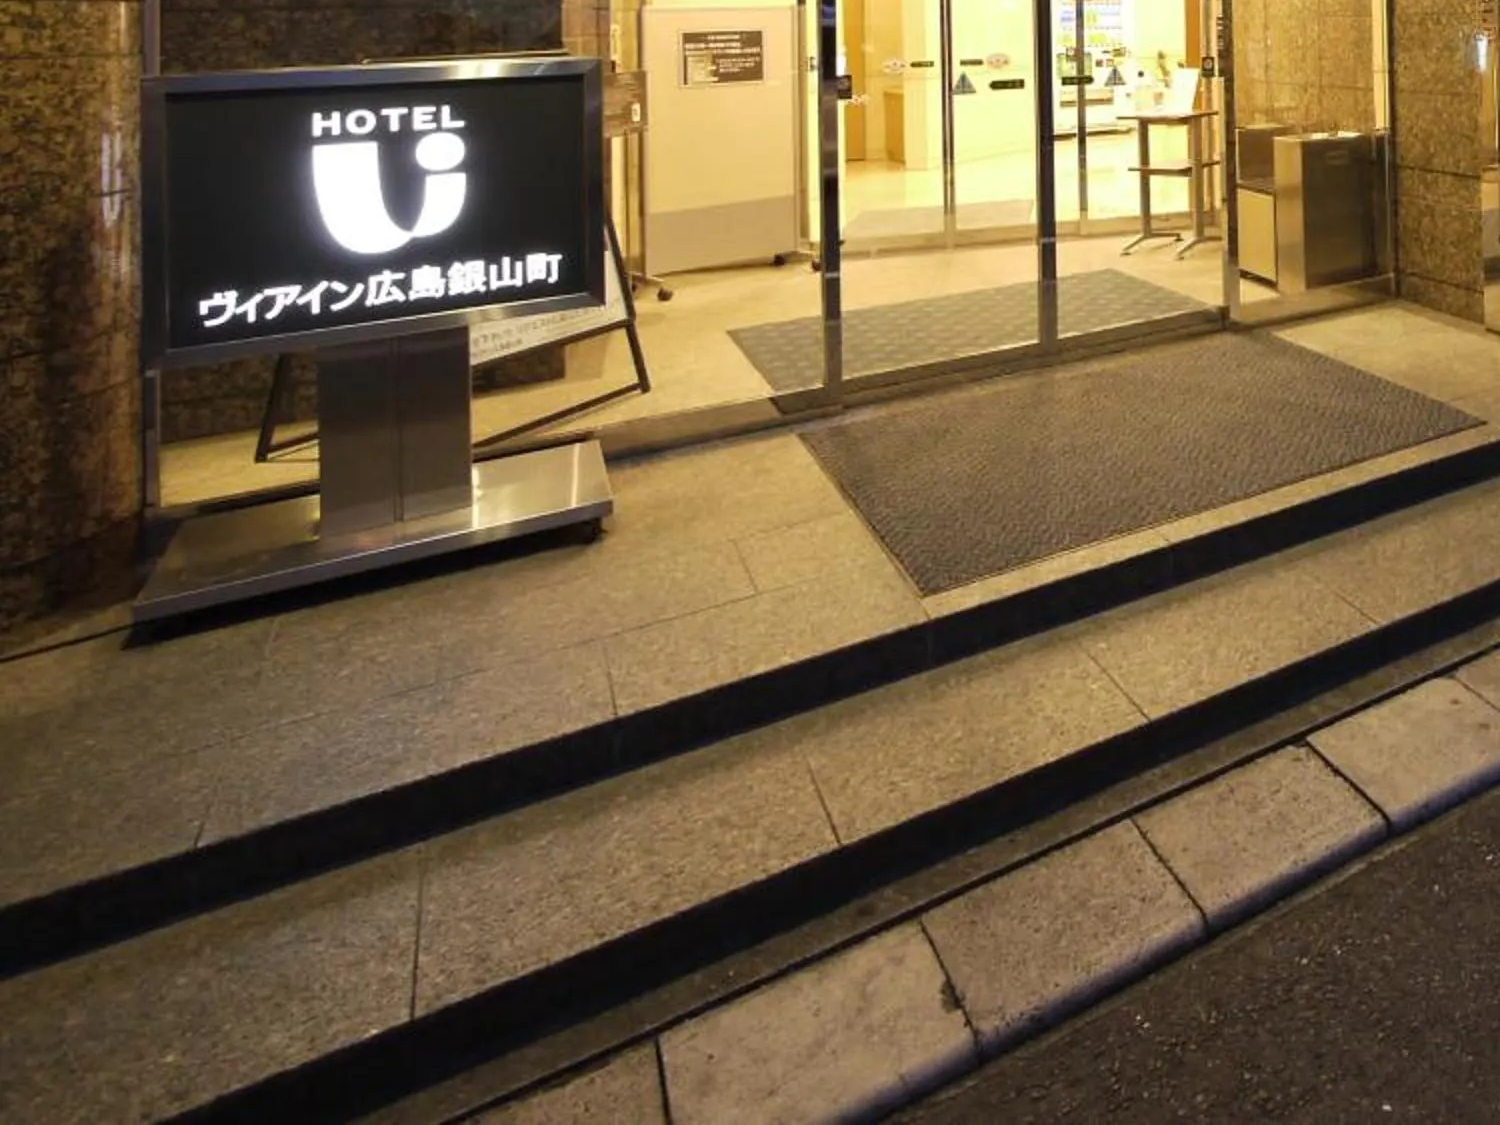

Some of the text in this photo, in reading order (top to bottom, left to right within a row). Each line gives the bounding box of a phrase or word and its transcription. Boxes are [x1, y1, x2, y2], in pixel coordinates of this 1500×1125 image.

[312, 104, 466, 137] HOTEL
[199, 252, 563, 327] ヴィアイン広島銀山町
